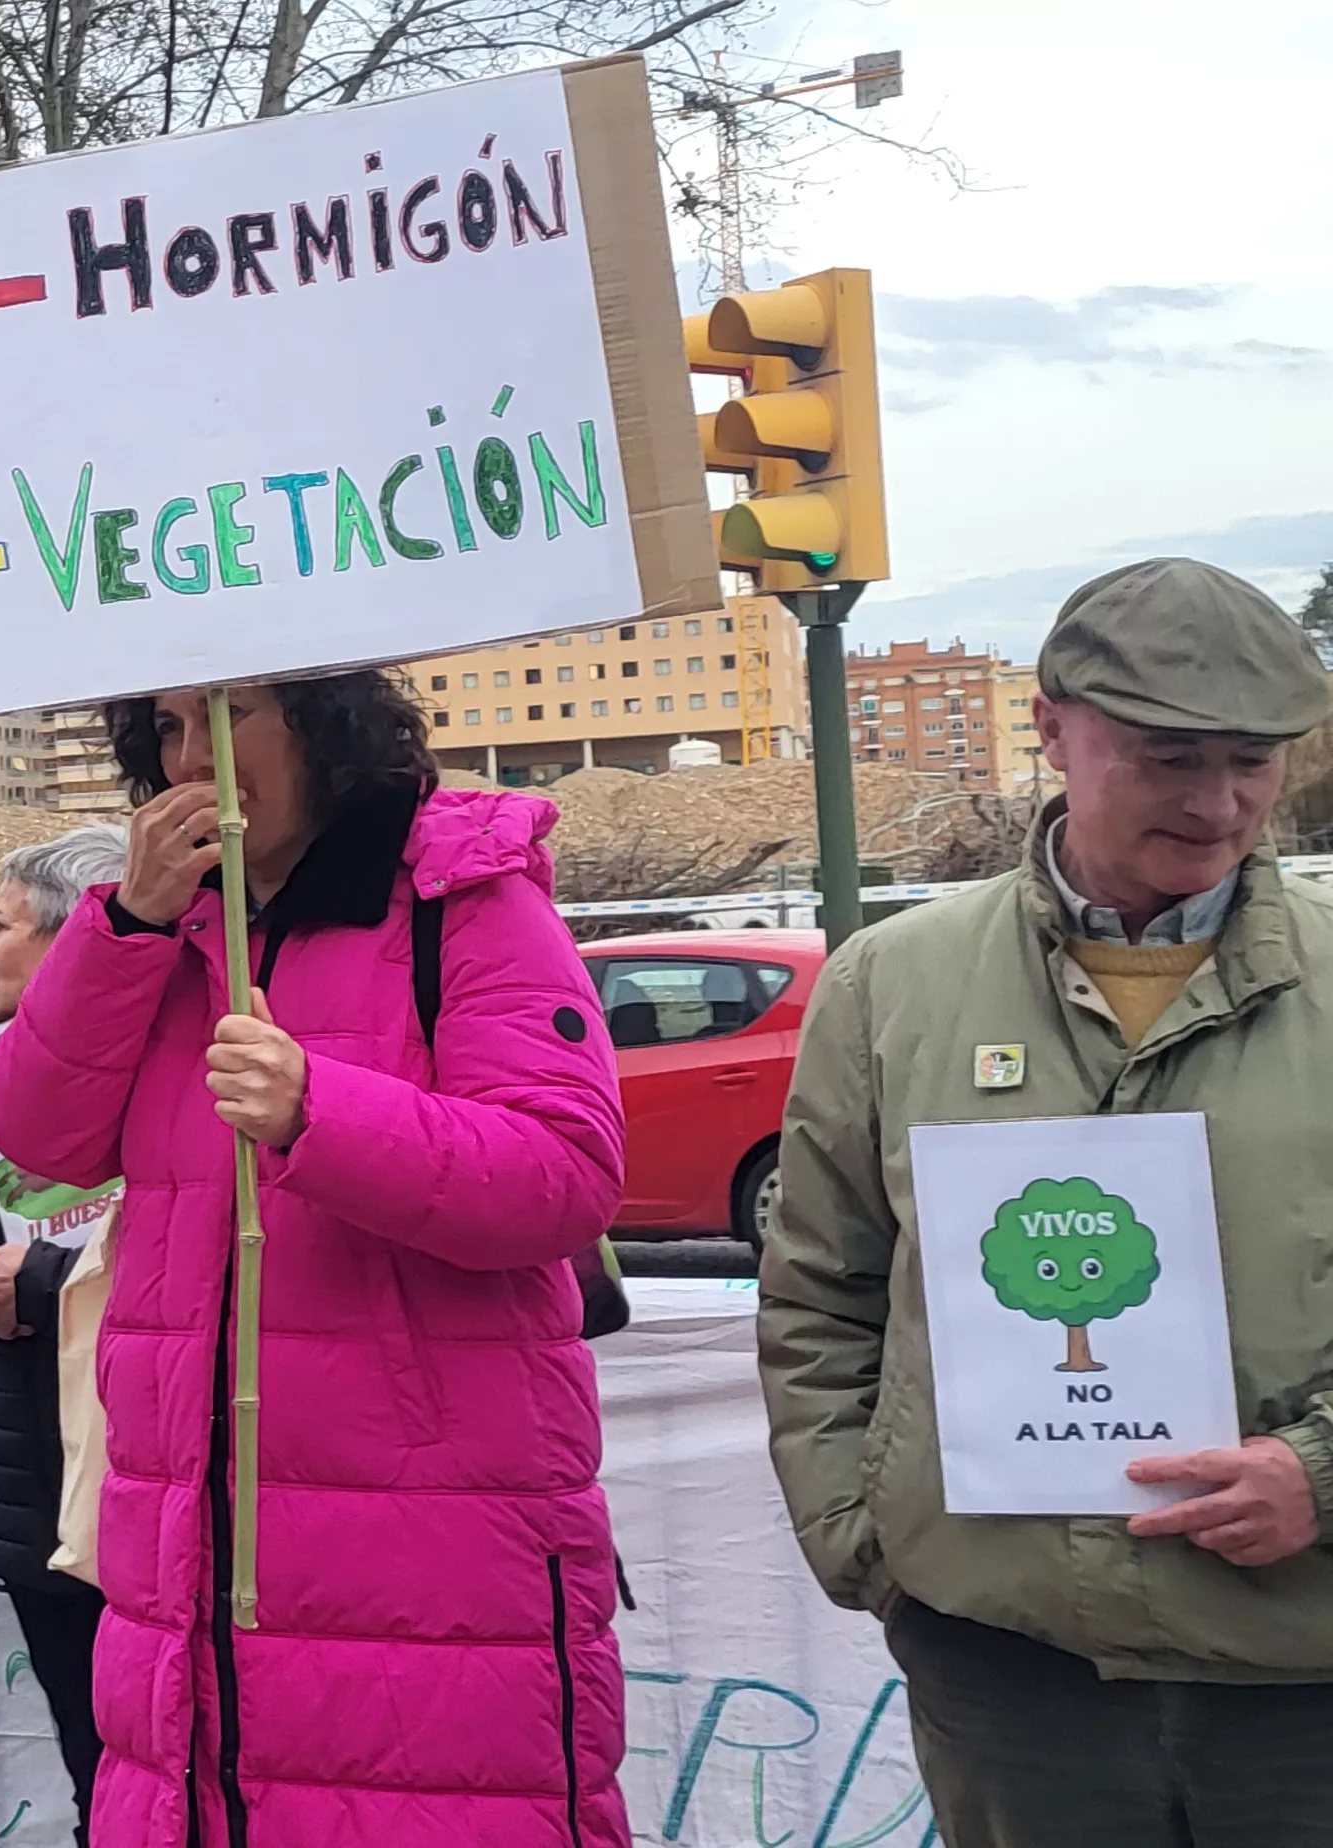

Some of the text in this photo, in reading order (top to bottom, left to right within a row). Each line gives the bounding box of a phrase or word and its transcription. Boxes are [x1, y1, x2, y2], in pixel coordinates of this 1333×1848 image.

[1018, 1209, 1118, 1238] VIVOS
[1066, 1384, 1114, 1404] NO
[1015, 1421, 1173, 1441] A LA TALA
